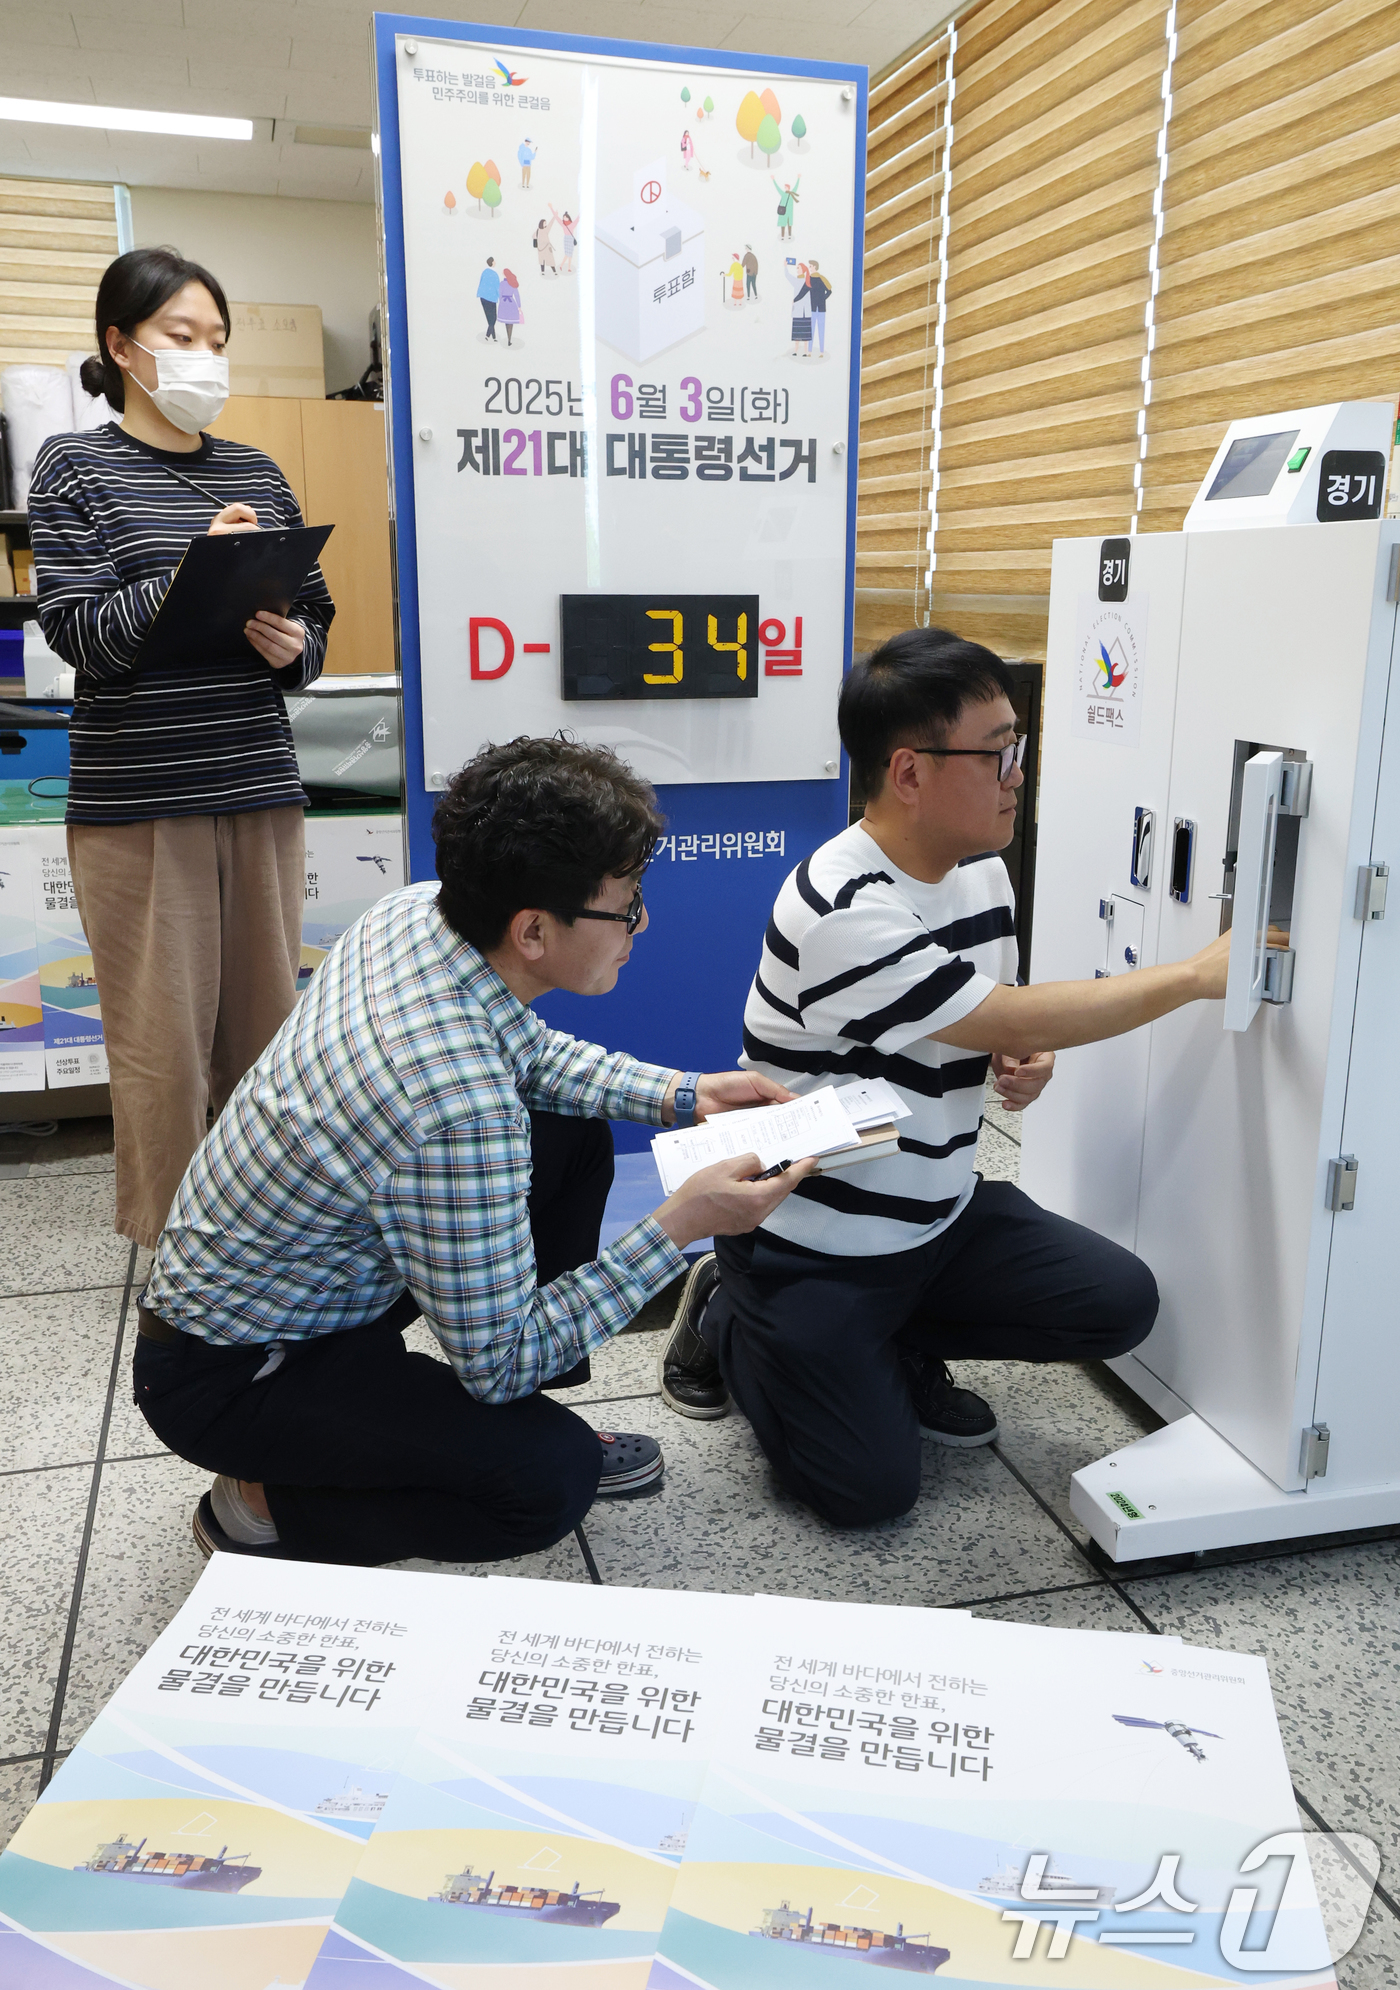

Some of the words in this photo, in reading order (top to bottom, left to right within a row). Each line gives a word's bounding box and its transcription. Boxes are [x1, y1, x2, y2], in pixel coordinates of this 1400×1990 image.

[413, 68, 459, 85] 투표하는
[462, 73, 496, 89] 발걸음
[432, 87, 489, 105] 민주주의를
[492, 92, 515, 108] 위한
[518, 95, 551, 111] 큰걸음
[653, 267, 696, 304] 투표함
[611, 373, 667, 420] 6월
[680, 376, 789, 425] 3일(화)
[456, 428, 588, 478] 제21대
[605, 432, 817, 483] 대통령선거
[1327, 475, 1376, 506] 경기
[1102, 559, 1126, 586] 경기
[1079, 635, 1091, 691] NATIONAL
[1092, 612, 1122, 630] ELECTION
[1124, 623, 1139, 698] COMMISSION
[1087, 705, 1124, 728] 쉴드팩스
[197, 1624, 256, 1642] 당신의
[256, 1631, 316, 1646] 소중한
[320, 1634, 360, 1650] 한표,
[210, 1607, 230, 1621] 전
[232, 1609, 272, 1625] 세계
[274, 1612, 350, 1632] 바다에서
[352, 1619, 408, 1637] 전하는
[179, 1645, 327, 1676] 대한민국을
[331, 1657, 396, 1684] 위한
[490, 1648, 549, 1668] 당신의
[551, 1656, 612, 1674] 소중한
[616, 1661, 659, 1679] 한표,
[497, 1630, 518, 1645] 전
[520, 1633, 560, 1650] 세계
[563, 1637, 640, 1657] 바다에서
[645, 1644, 703, 1664] 전하는
[157, 1669, 252, 1697] 물결을
[258, 1678, 381, 1711] 만듭니다
[478, 1670, 630, 1706] 대한민국을
[637, 1686, 702, 1713] 위한
[769, 1675, 828, 1697] 당신의
[833, 1684, 896, 1706] 소중한
[900, 1691, 946, 1713] 한표,
[773, 1655, 793, 1671] 전
[797, 1658, 837, 1677] 세계
[842, 1663, 922, 1688] 바다에서
[927, 1674, 988, 1697] 전하는
[1170, 1668, 1246, 1685] 중앙선거관리위원회
[465, 1696, 559, 1727] 물결을
[568, 1707, 695, 1743] 만듭니다
[761, 1698, 919, 1741] 대한민국을
[928, 1721, 995, 1750] 위한
[754, 1726, 850, 1761] 물결을
[860, 1741, 993, 1782] 만듭니다
